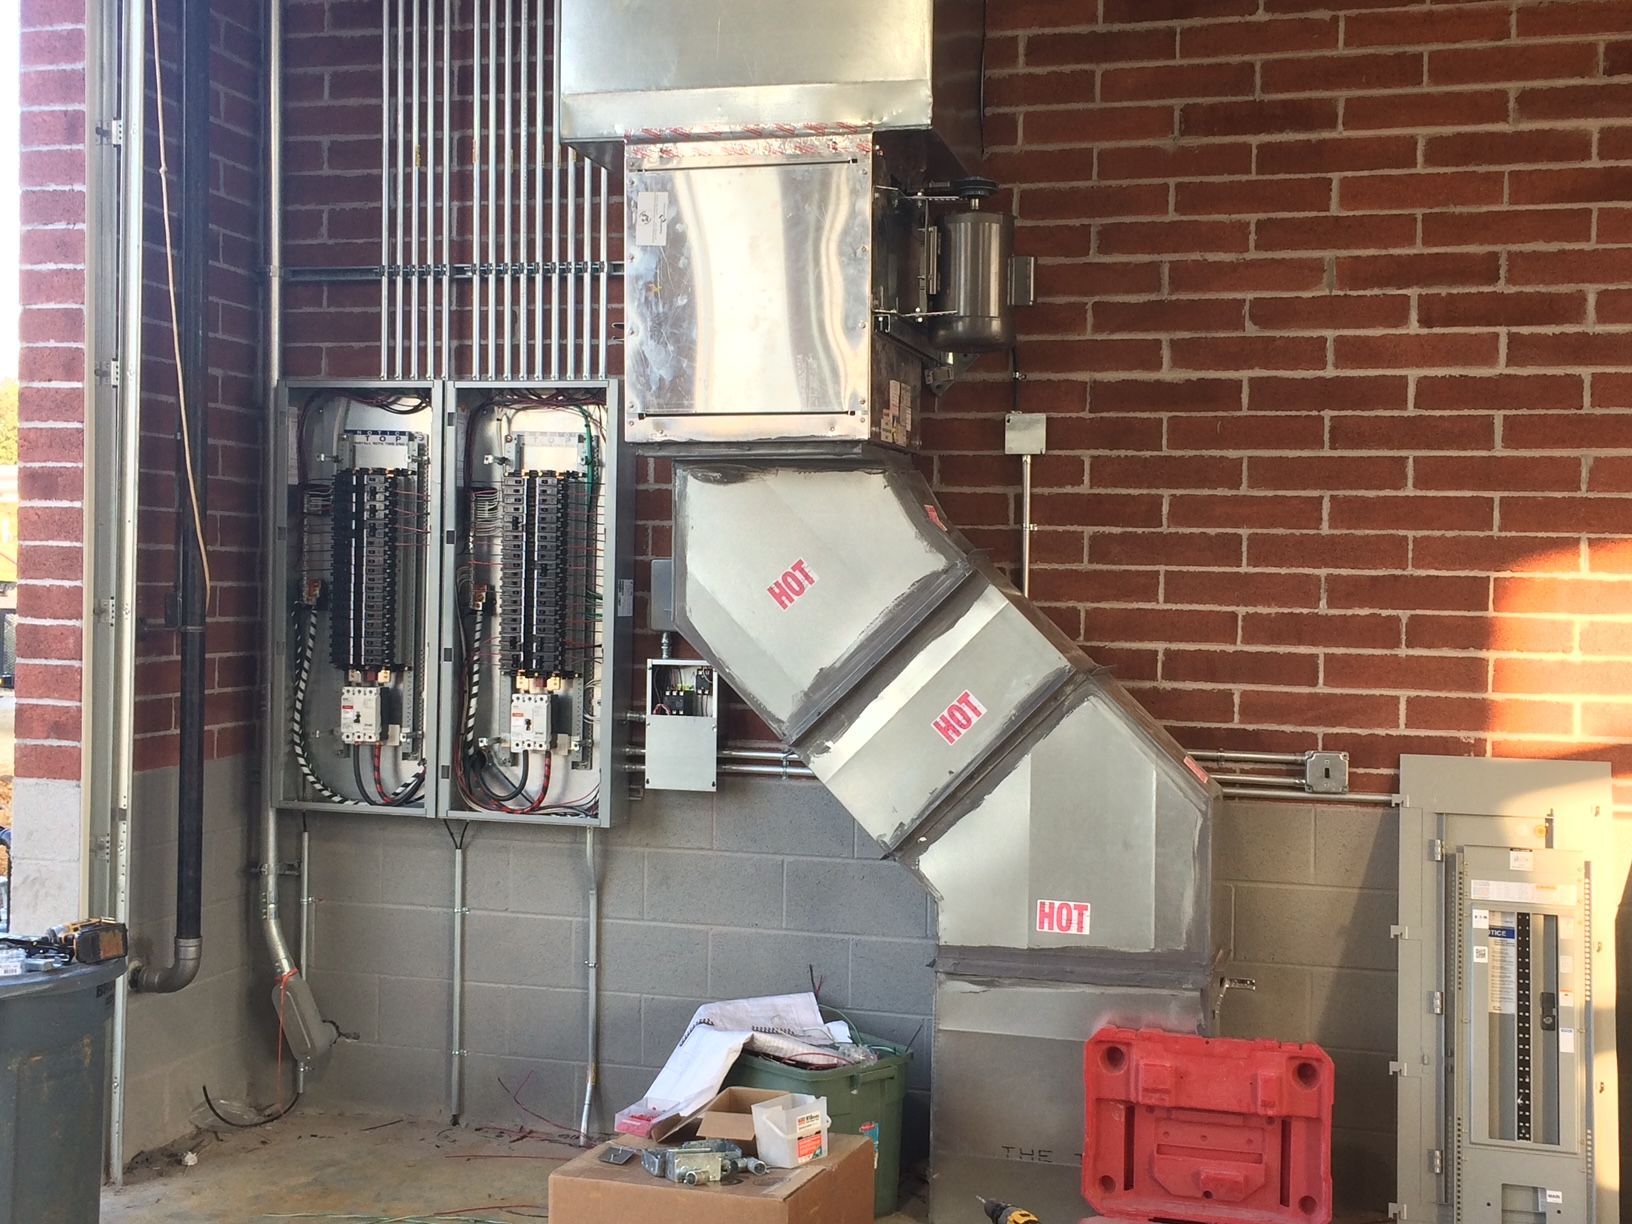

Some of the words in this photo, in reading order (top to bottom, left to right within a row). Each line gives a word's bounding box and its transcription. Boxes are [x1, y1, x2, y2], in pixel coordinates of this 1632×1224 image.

[767, 559, 816, 610] HOT
[933, 692, 982, 744] HOT
[1039, 901, 1089, 933] HOT
[1488, 929, 1507, 937] TICE
[1001, 1146, 1053, 1163] THE
